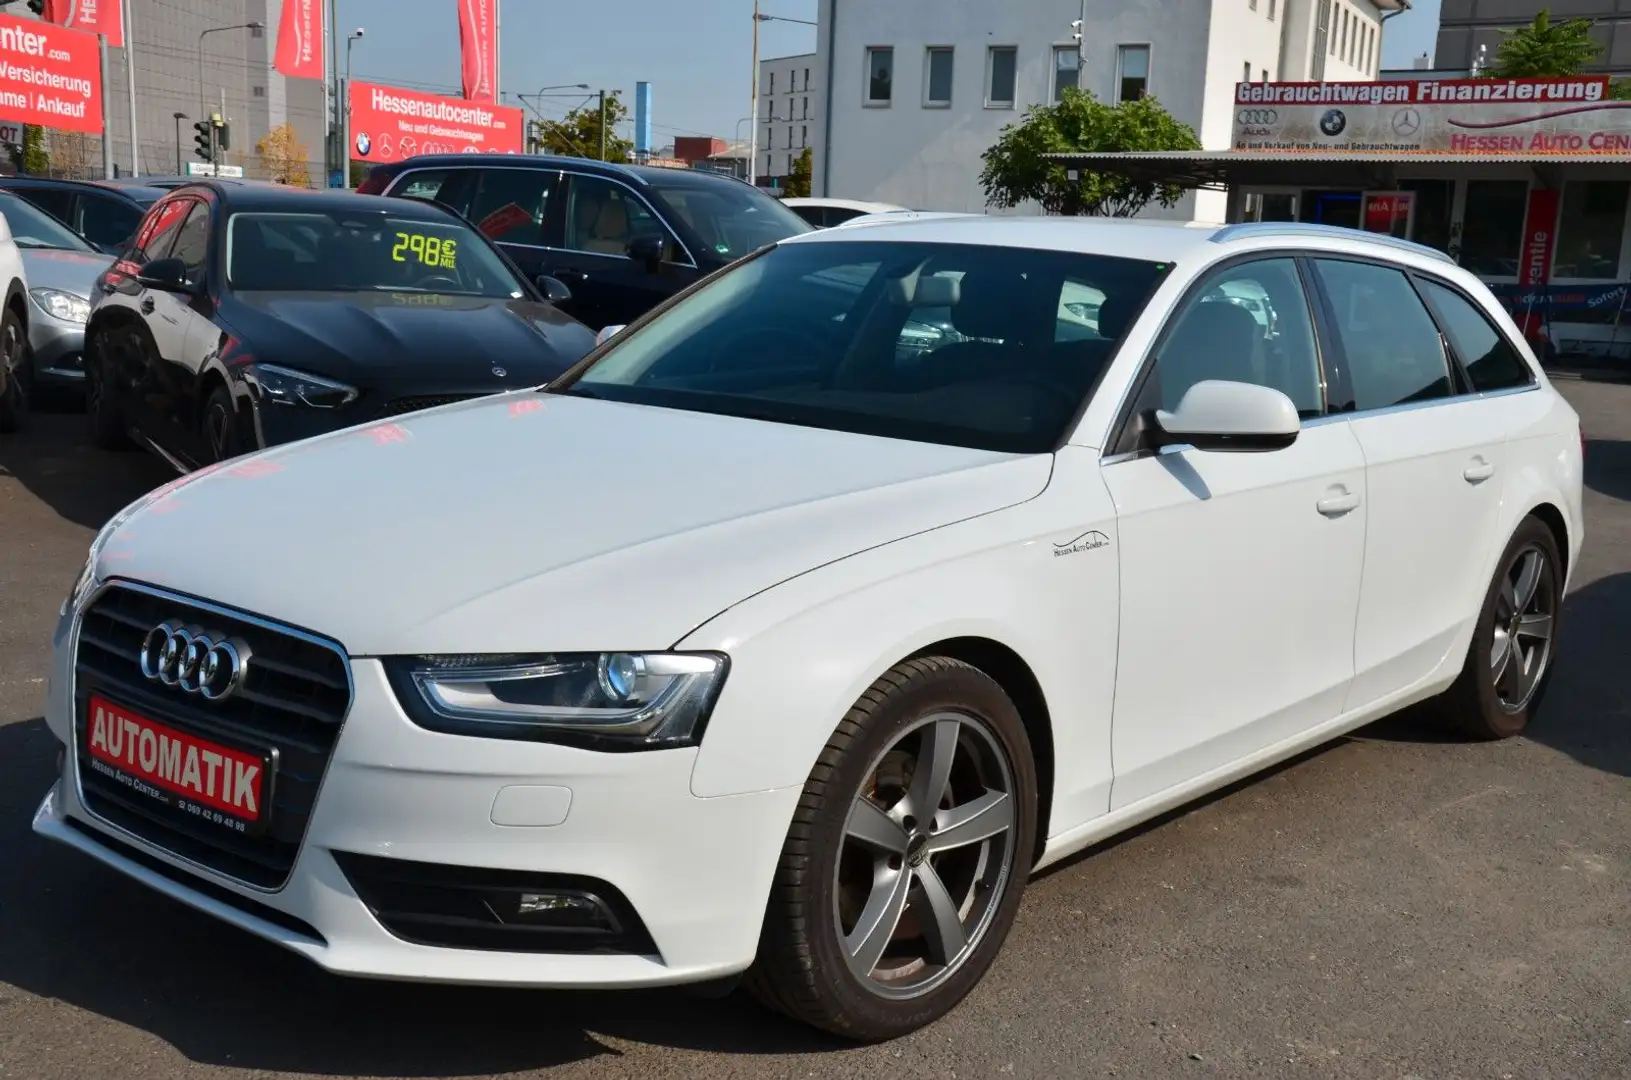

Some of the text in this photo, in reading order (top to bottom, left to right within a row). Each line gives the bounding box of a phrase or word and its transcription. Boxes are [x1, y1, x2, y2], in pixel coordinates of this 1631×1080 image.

[1237, 80, 1603, 104] Gebrauchtwagen Finanzierung
[37, 93, 85, 118] Ankauf
[1264, 141, 1294, 149] Verkauf
[1297, 142, 1310, 150] von
[1334, 142, 1349, 150] und
[1351, 142, 1420, 151] Gebrauchtwagen
[1451, 133, 1524, 150] HESSEN
[1529, 131, 1583, 150] AUTO
[91, 706, 260, 813] AUTOMATIK
